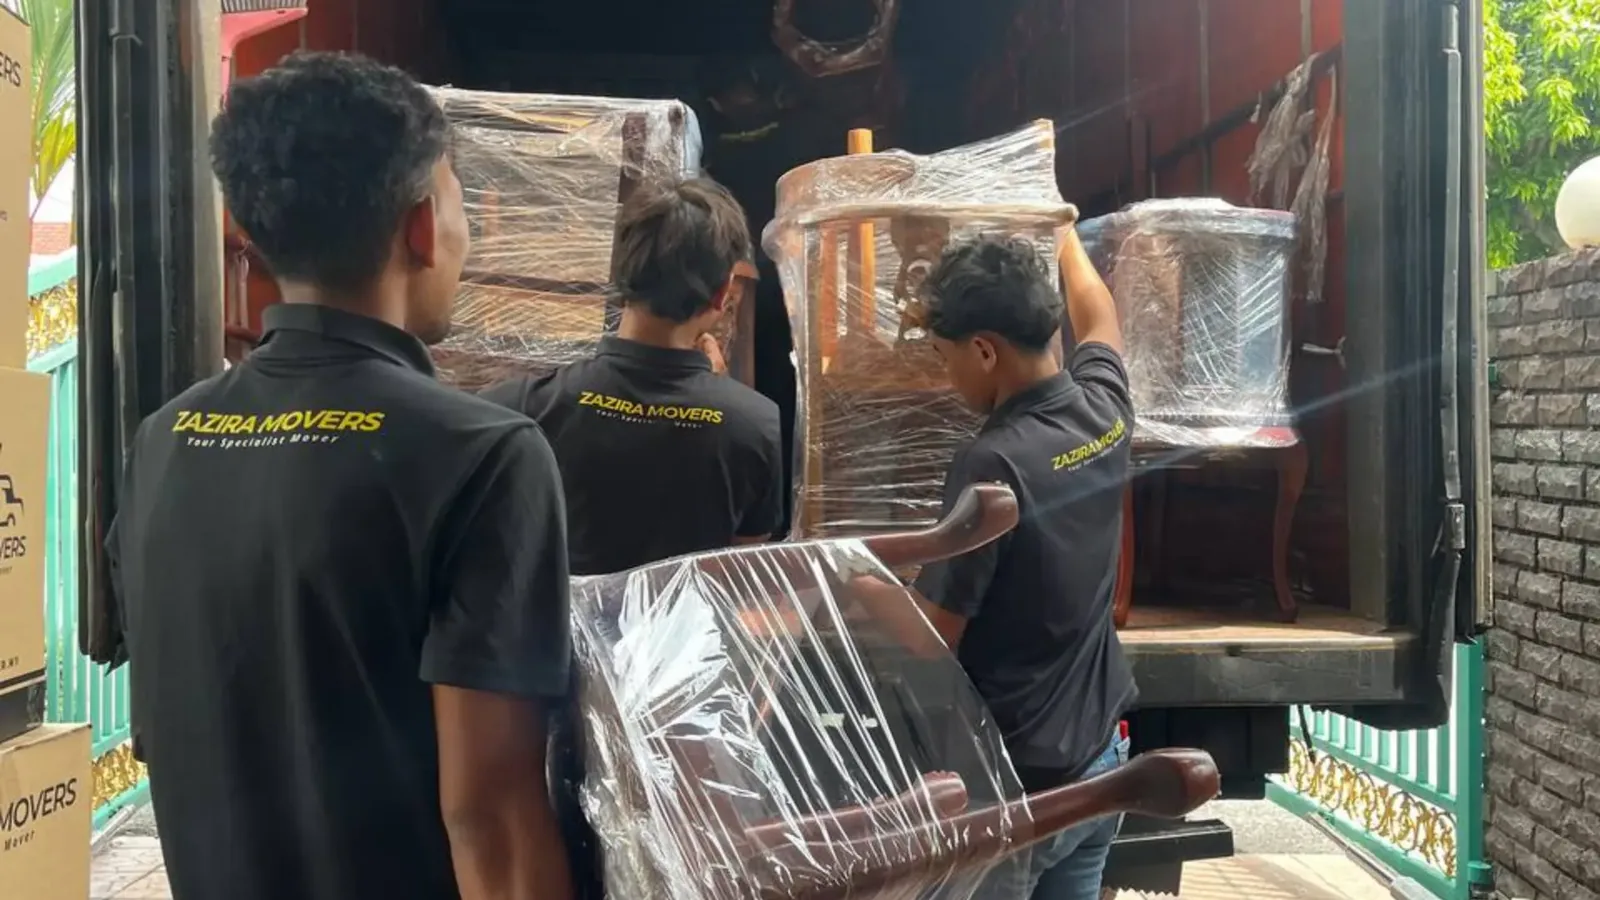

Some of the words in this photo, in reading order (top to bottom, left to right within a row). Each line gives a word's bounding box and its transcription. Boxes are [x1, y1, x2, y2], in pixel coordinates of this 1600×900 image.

[578, 391, 644, 416] ZAZIRA
[647, 405, 724, 424] MOVERS
[171, 411, 255, 434] ZAZIRA
[257, 410, 385, 433] MOVERS
[187, 436, 216, 448] Your
[219, 435, 286, 449] Specialist
[289, 433, 339, 444] Mover
